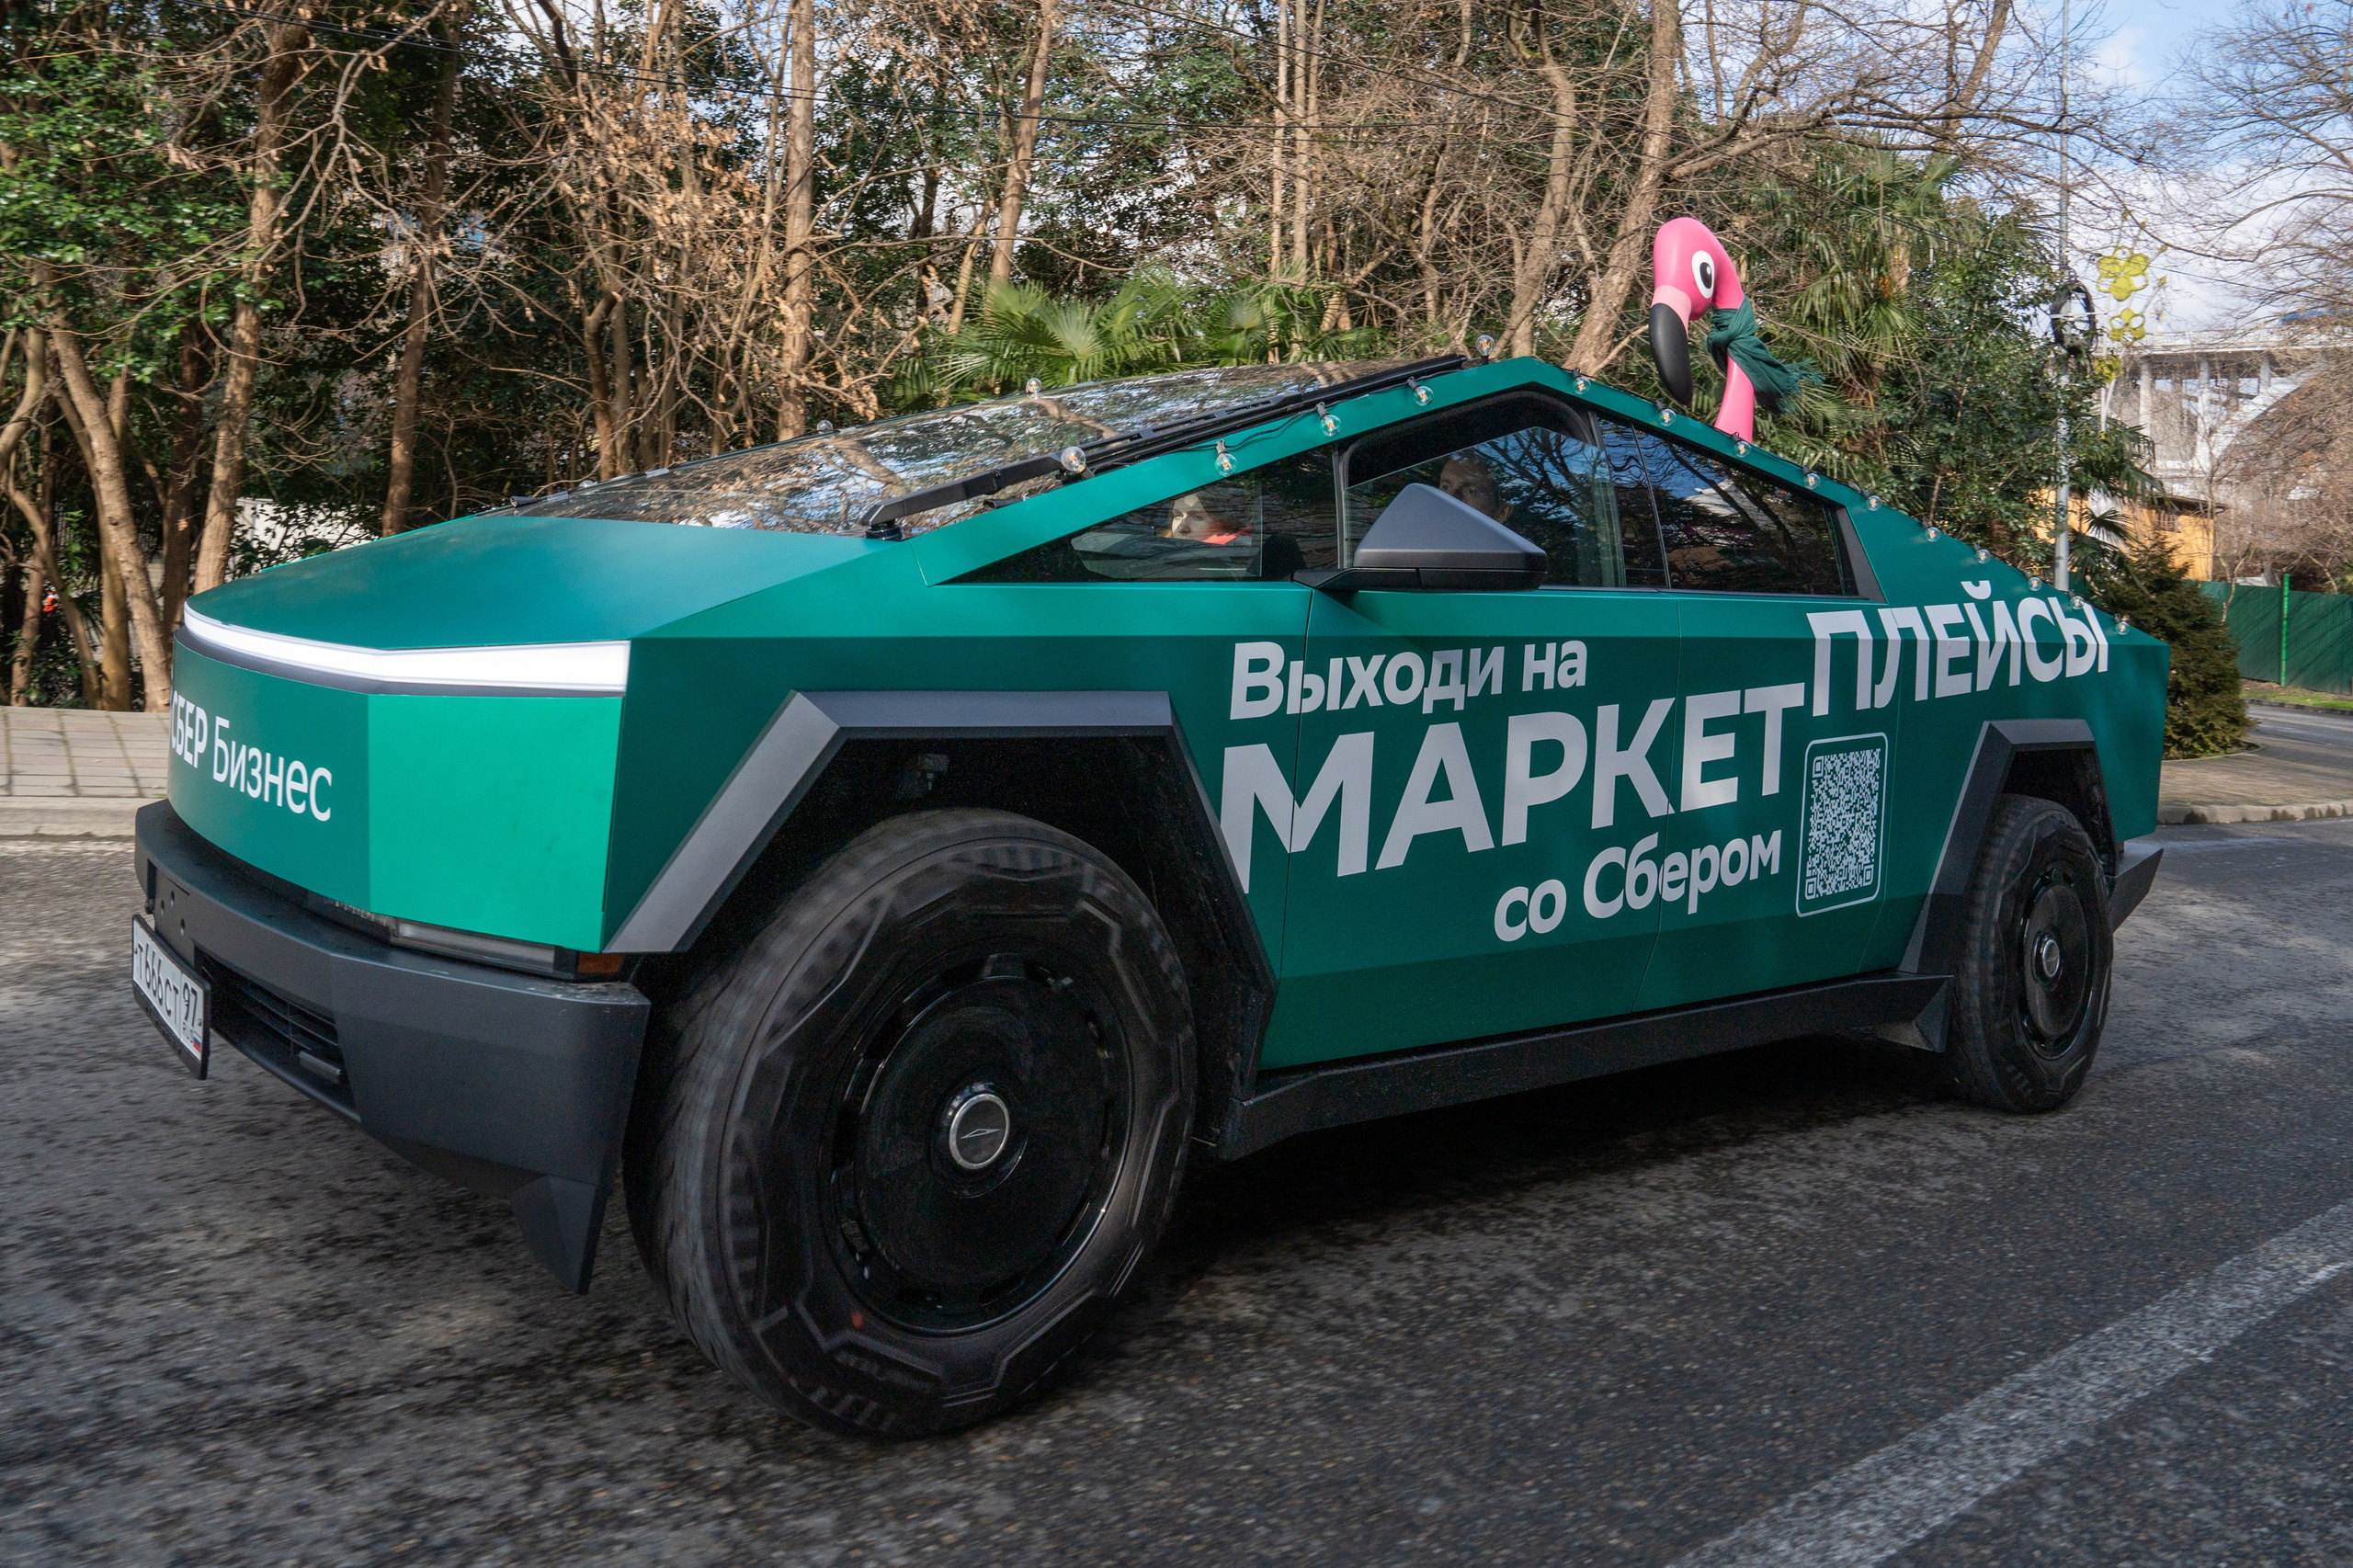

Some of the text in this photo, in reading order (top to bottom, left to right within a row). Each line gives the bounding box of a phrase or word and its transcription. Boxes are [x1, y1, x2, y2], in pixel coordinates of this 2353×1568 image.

[1220, 580, 2109, 894] МАРКЕТ ПЛЕЙСЫ
[1230, 640, 1587, 721] Выходи на
[171, 690, 333, 822] СБЕР Бизнес
[1494, 829, 1782, 943] со Сбером
[182, 983, 199, 1028] 97
